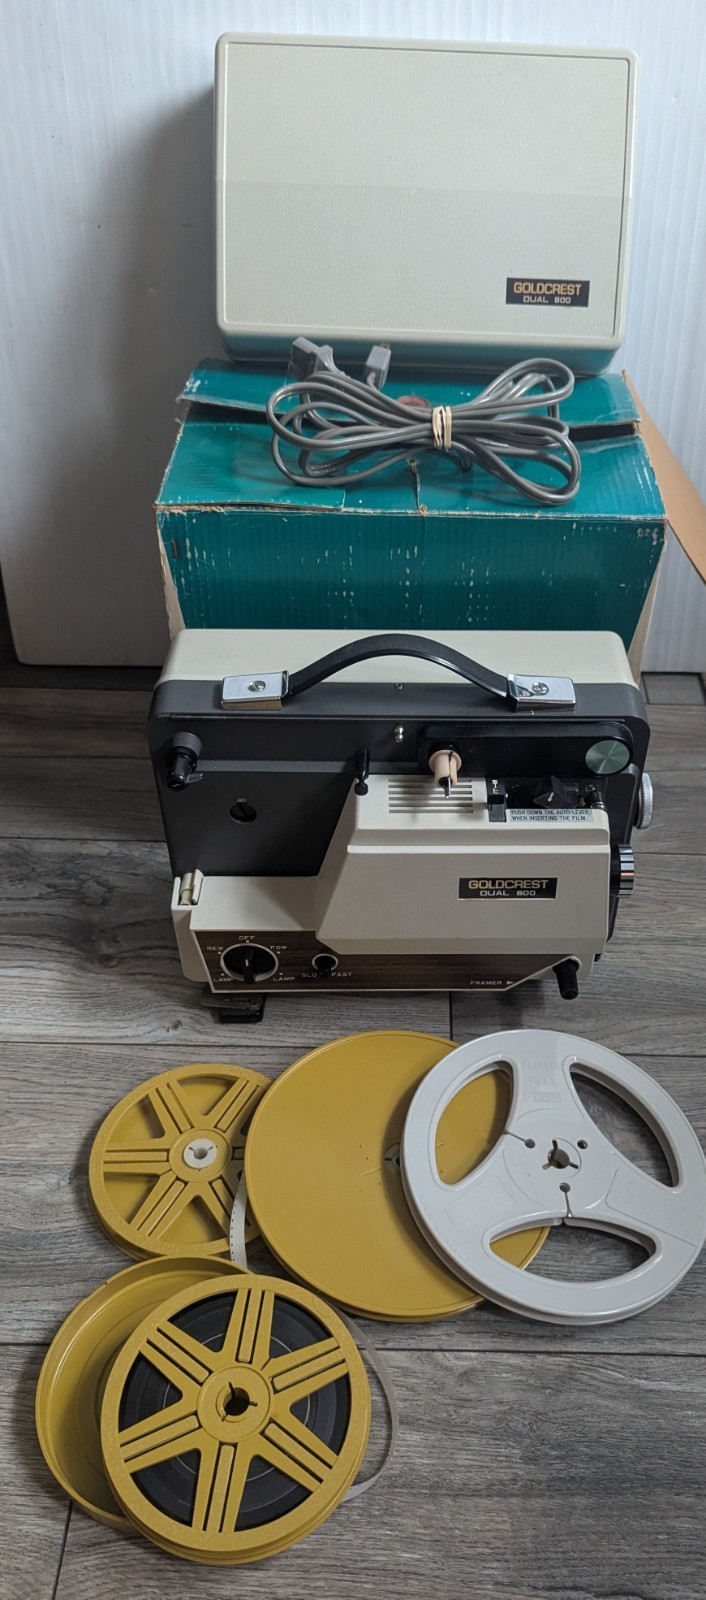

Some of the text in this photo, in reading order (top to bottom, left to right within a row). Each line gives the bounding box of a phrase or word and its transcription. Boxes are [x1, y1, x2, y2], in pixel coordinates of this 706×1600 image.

[513, 281, 582, 296] GOLDCREST
[523, 295, 572, 304] DUAL 800
[468, 879, 549, 889] GOLDCREST
